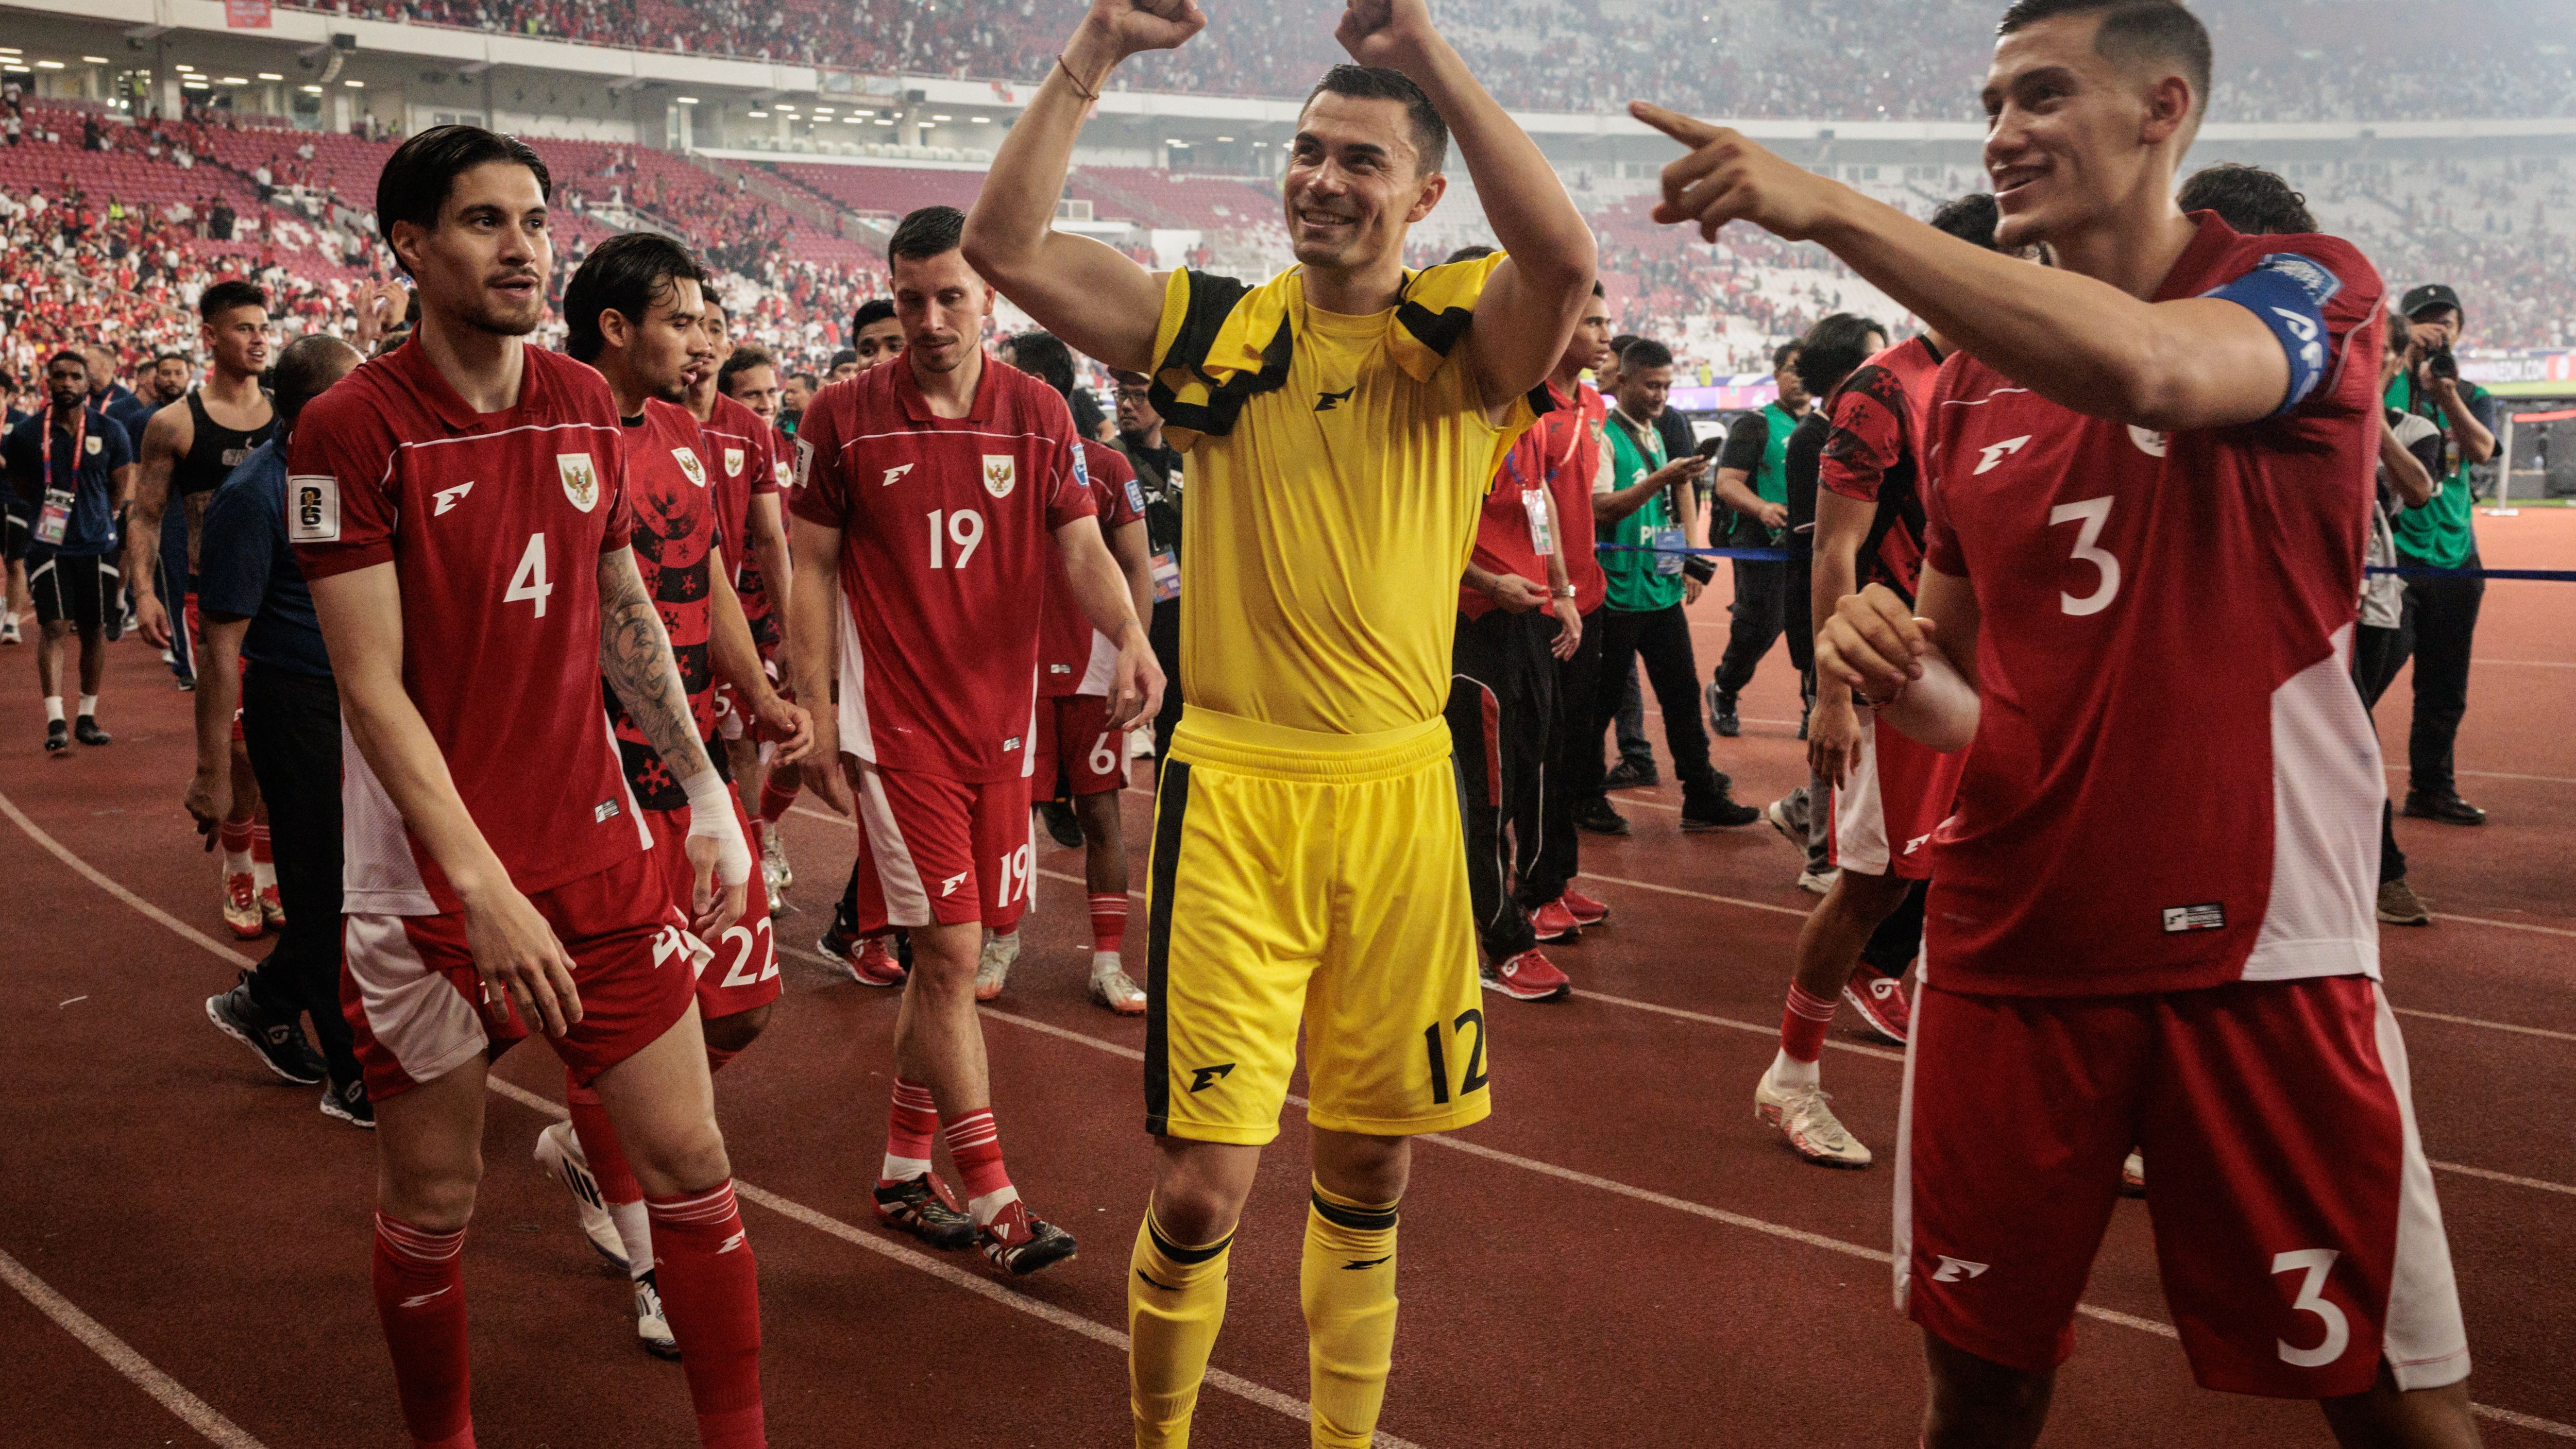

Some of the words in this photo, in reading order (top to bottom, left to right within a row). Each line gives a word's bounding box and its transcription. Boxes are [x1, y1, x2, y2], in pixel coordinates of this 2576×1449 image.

[503, 533, 553, 619] 4
[926, 508, 984, 569] 19
[2048, 495, 2121, 616] 3
[1089, 731, 1116, 775] 6
[998, 844, 1029, 908] 19
[720, 916, 779, 988] 22
[1424, 1009, 1488, 1104] 12
[2270, 1248, 2350, 1367] 3
